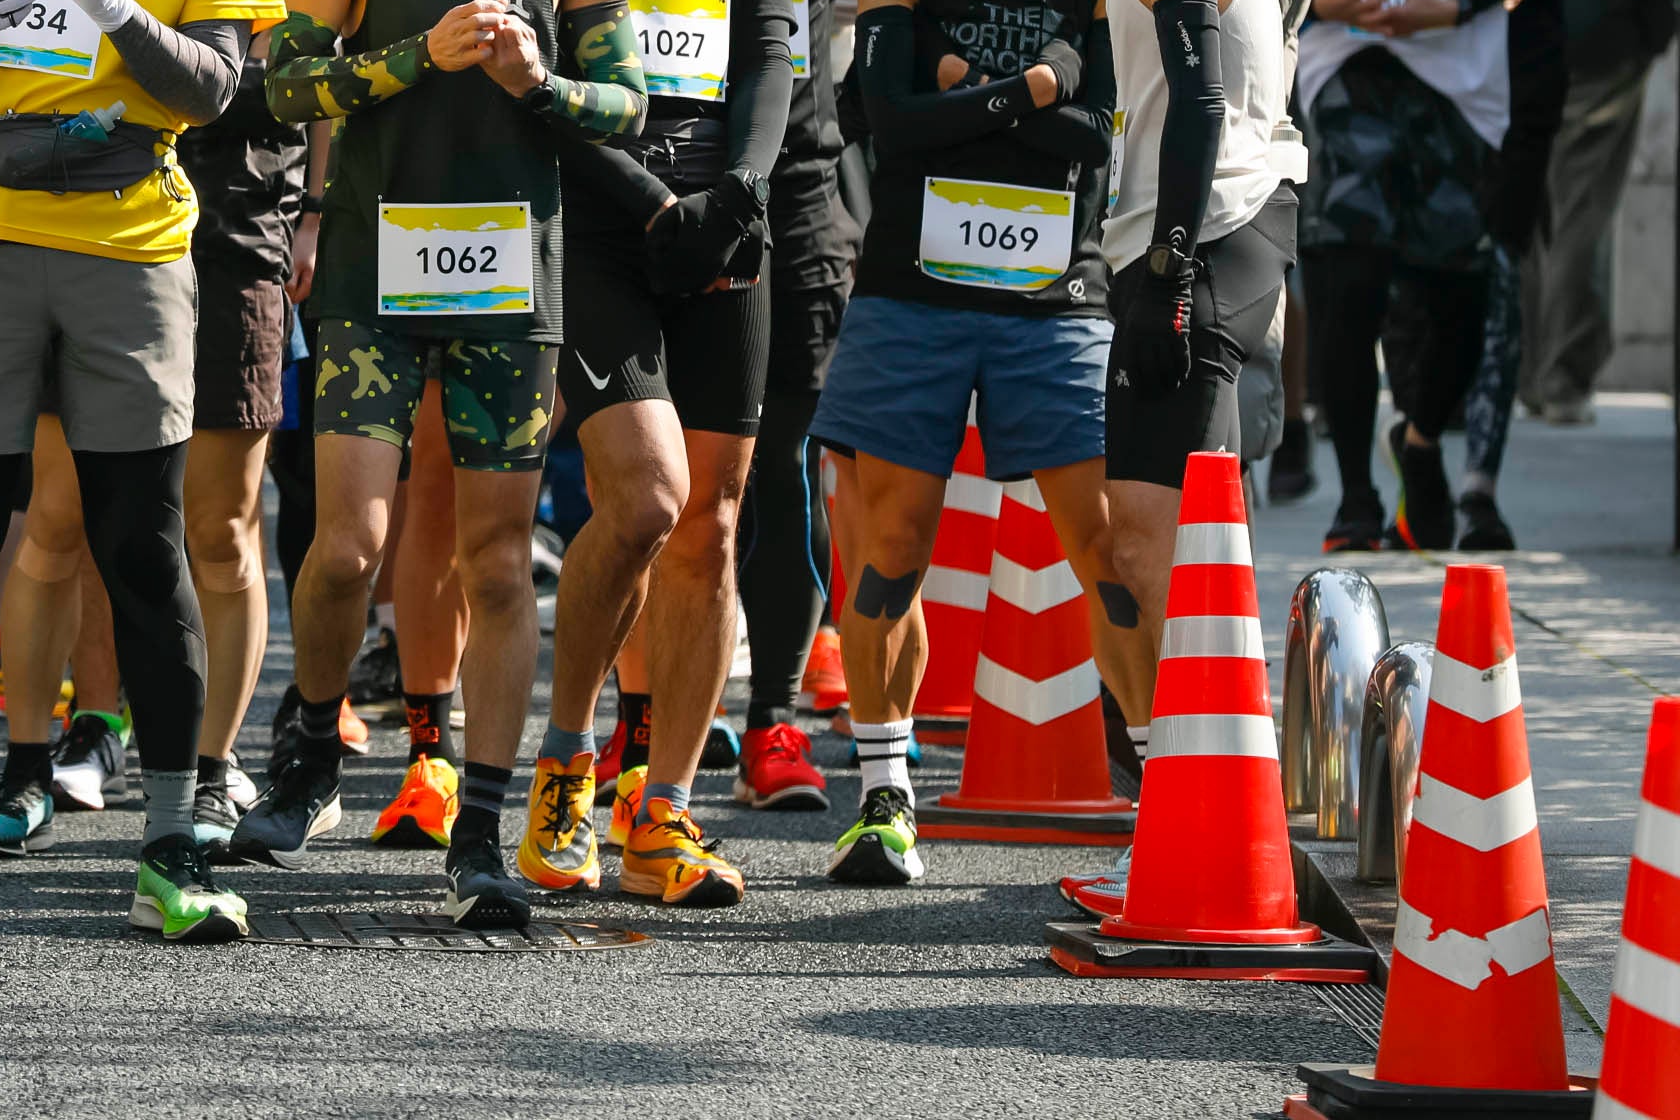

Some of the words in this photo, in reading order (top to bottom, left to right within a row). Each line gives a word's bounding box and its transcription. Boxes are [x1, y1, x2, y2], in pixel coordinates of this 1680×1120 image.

[983, 2, 1041, 28] THE
[638, 29, 705, 58] 1027
[959, 220, 1039, 252] 1069
[416, 245, 498, 274] 1062
